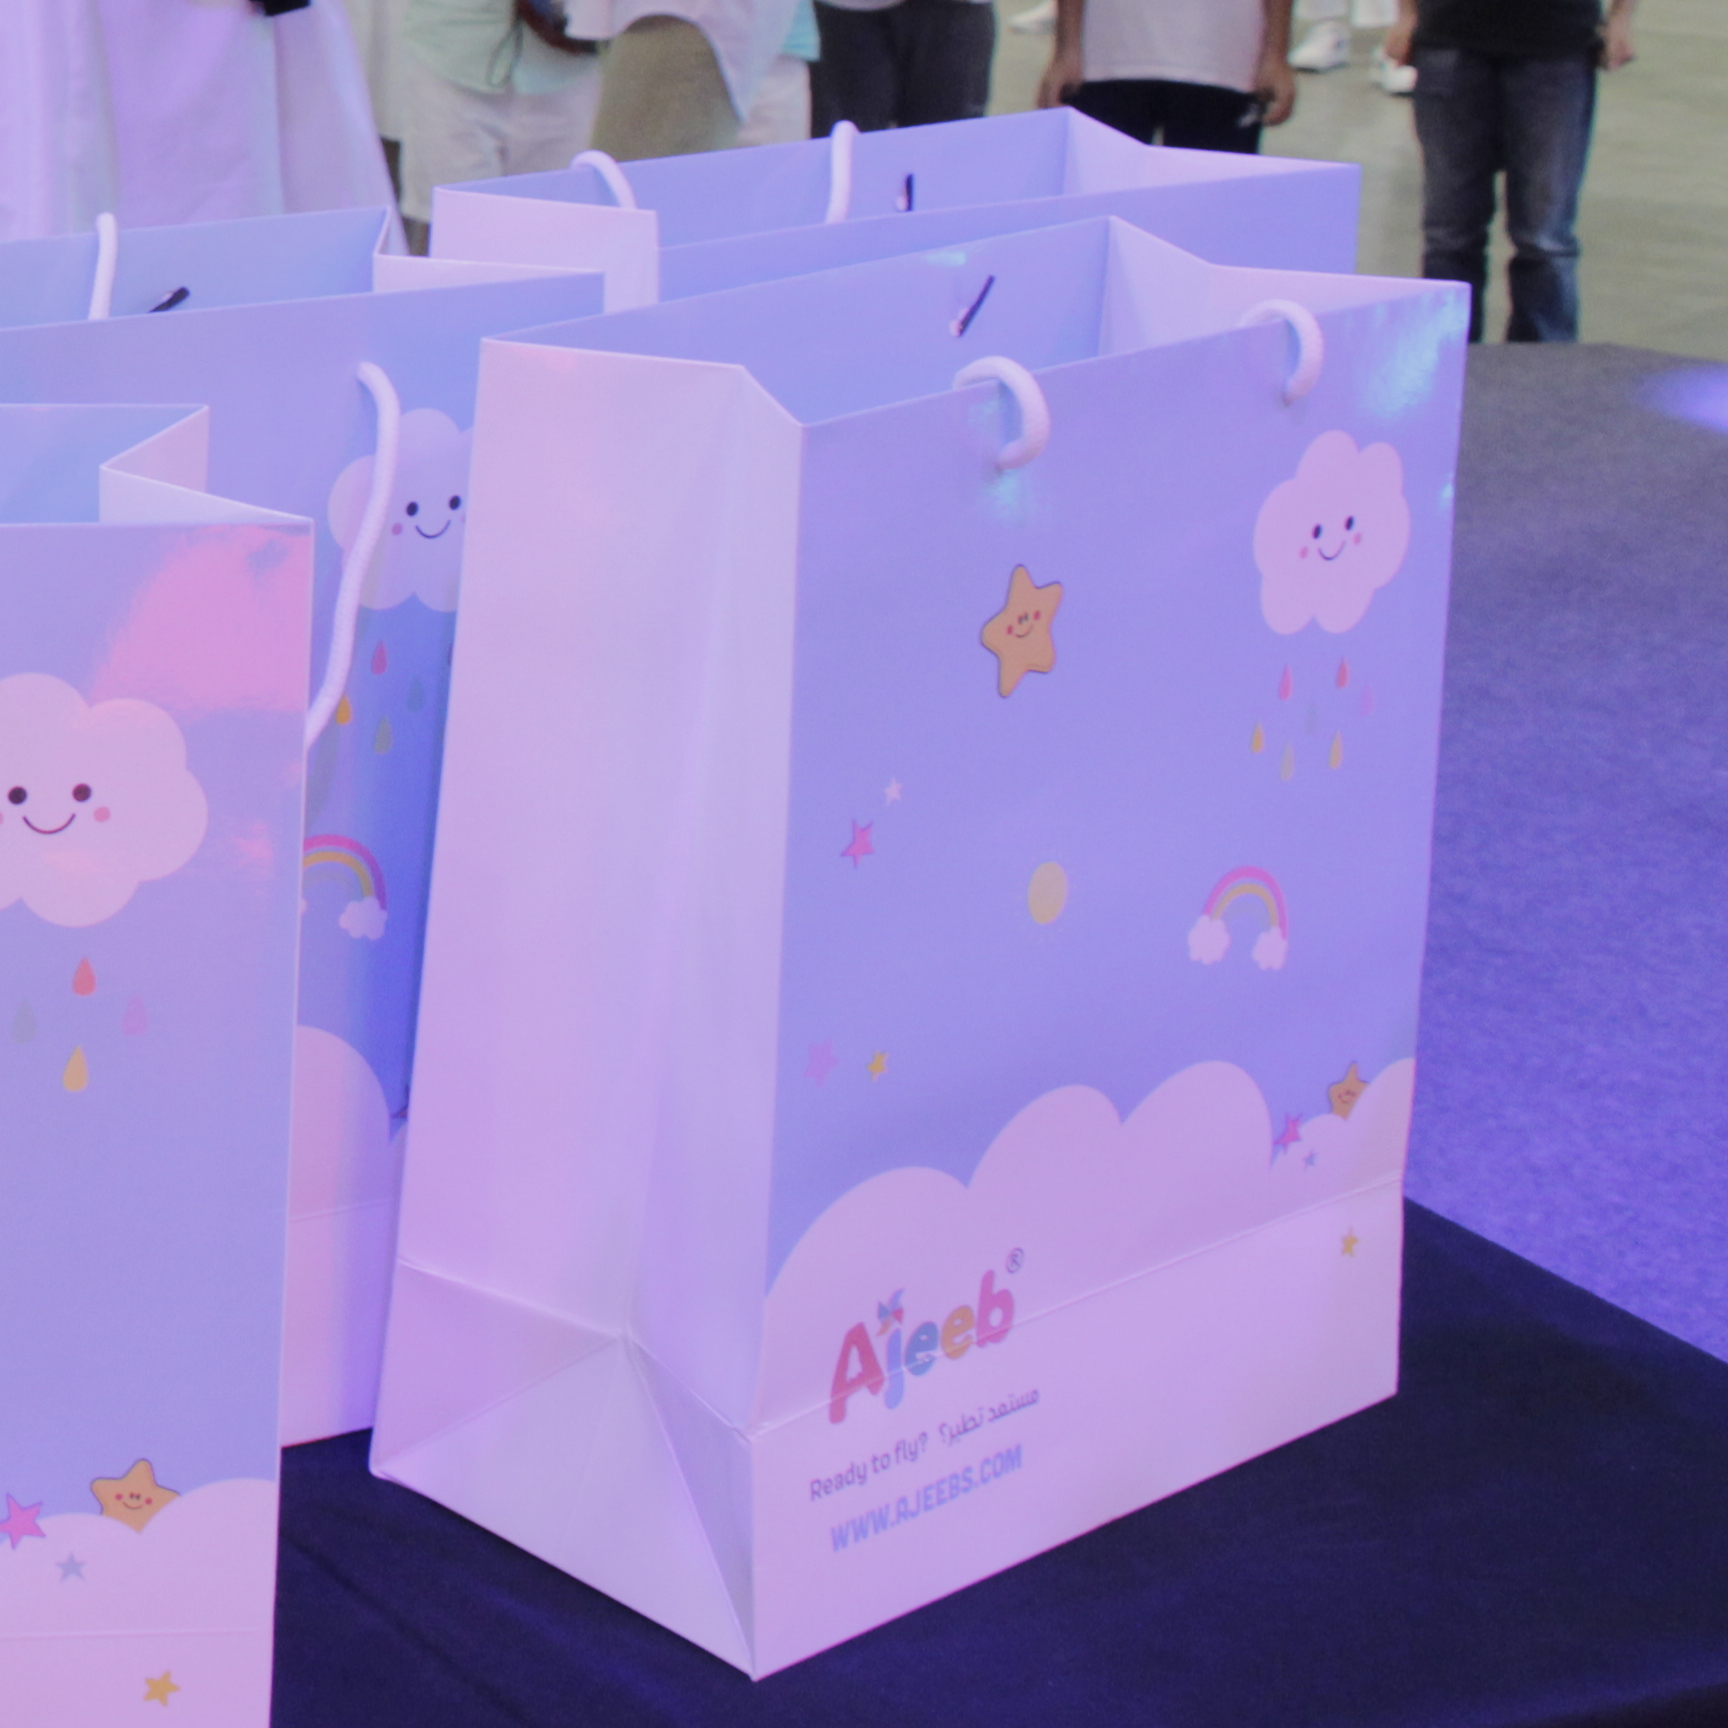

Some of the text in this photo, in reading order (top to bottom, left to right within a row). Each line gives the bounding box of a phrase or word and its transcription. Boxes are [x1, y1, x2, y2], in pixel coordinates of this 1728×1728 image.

[987, 1388, 1041, 1423] مستعد
[809, 1431, 929, 1502] Ready to fly?
[830, 1443, 1024, 1553] WWW.AJEEBS.COM
